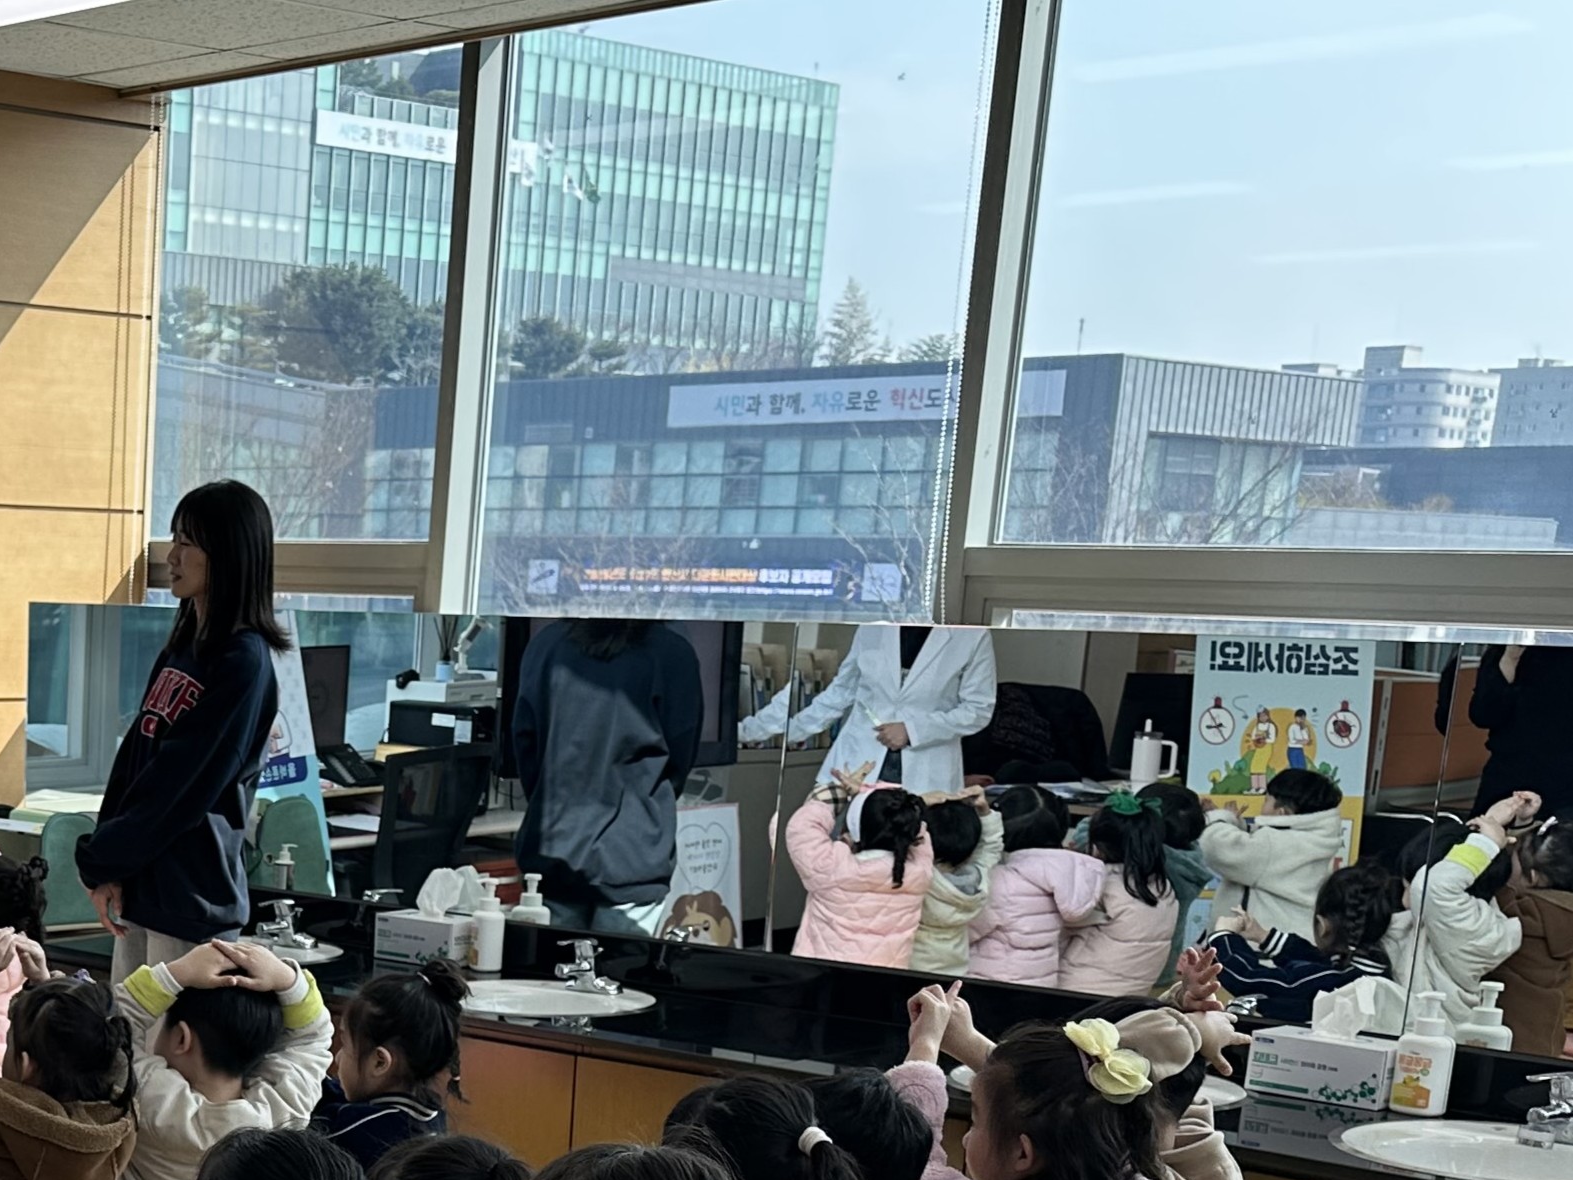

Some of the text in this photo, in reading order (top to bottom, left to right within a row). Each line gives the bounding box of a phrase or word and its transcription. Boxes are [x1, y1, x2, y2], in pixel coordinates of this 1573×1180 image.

[714, 393, 762, 417] 시민과
[768, 393, 805, 415] 함께,
[811, 389, 882, 413] 자유로운
